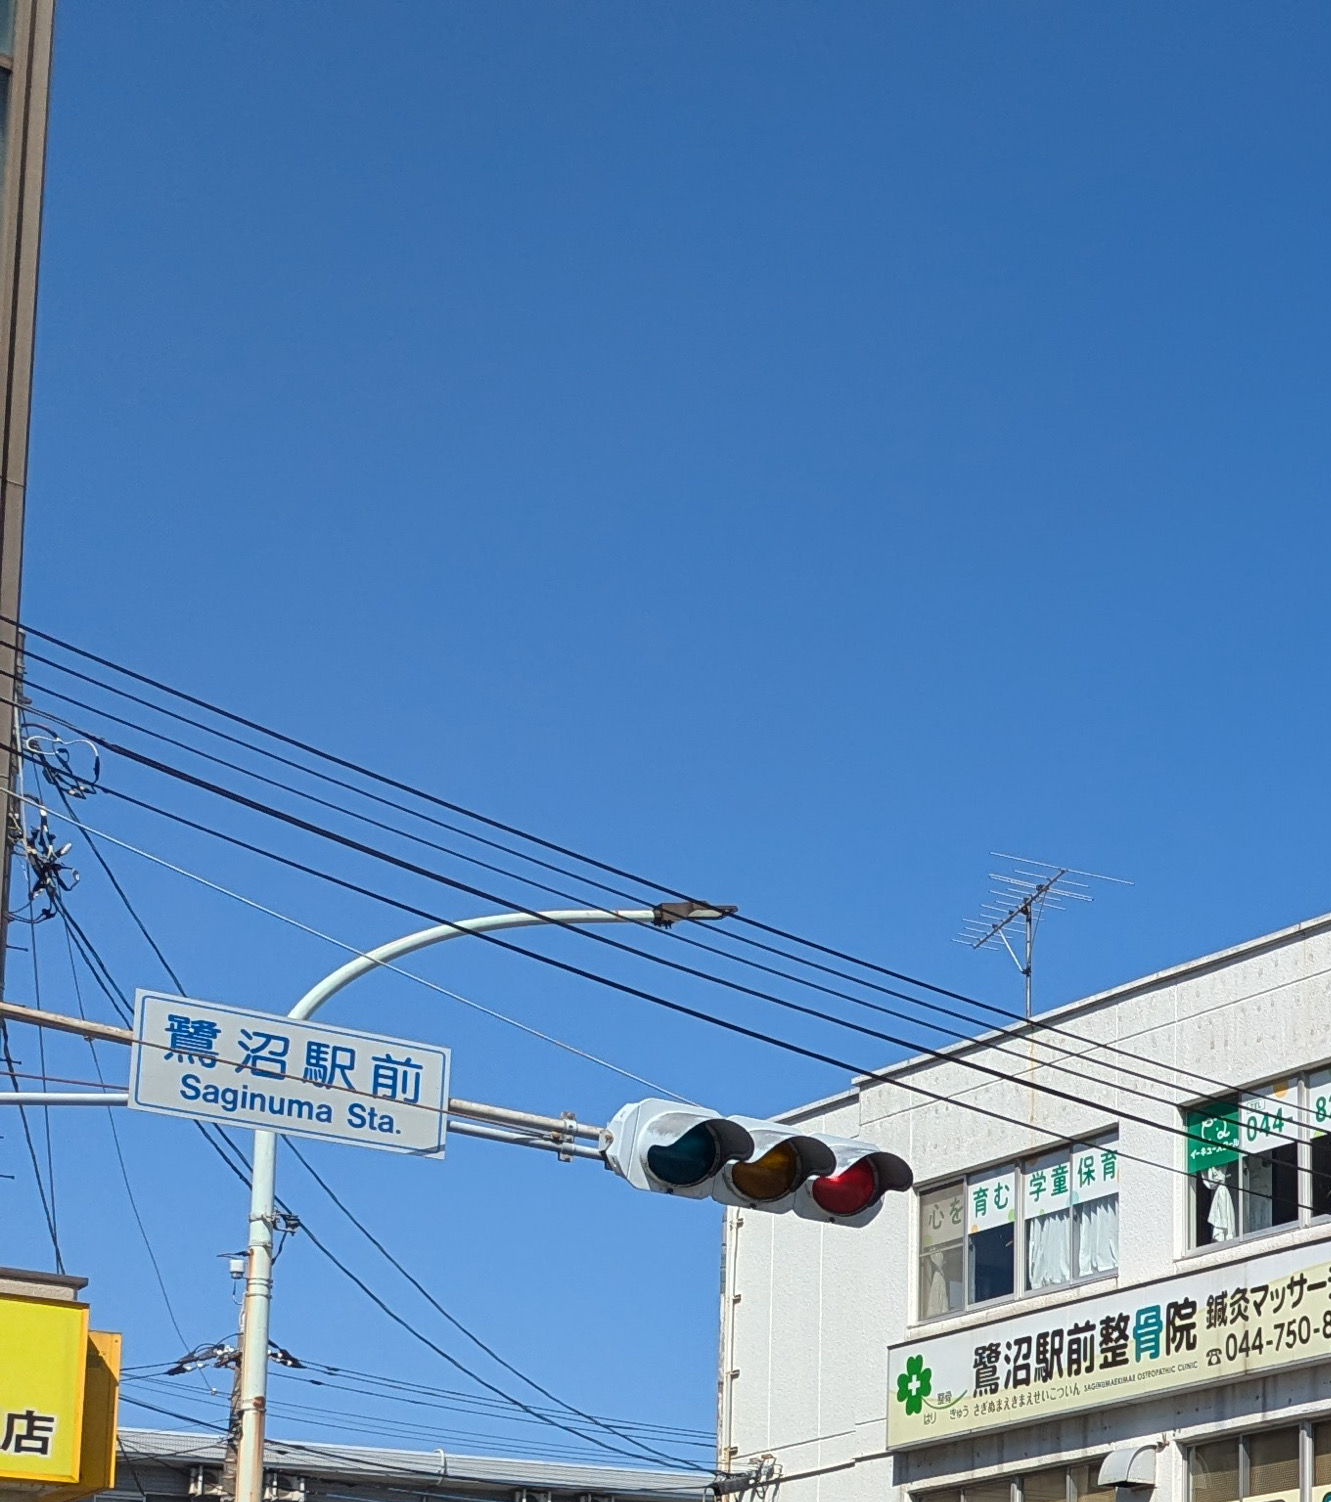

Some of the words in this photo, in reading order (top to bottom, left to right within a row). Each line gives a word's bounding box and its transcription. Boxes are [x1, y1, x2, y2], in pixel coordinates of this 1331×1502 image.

[164, 1013, 423, 1105] 鷺沼駅前
[180, 1073, 332, 1124] Saginuma
[347, 1101, 402, 1135] Sta.
[1029, 1150, 1118, 1202] 学童保育
[973, 1297, 1198, 1398] 鷺沼駅前整骨院
[1, 1411, 53, 1456] 店
